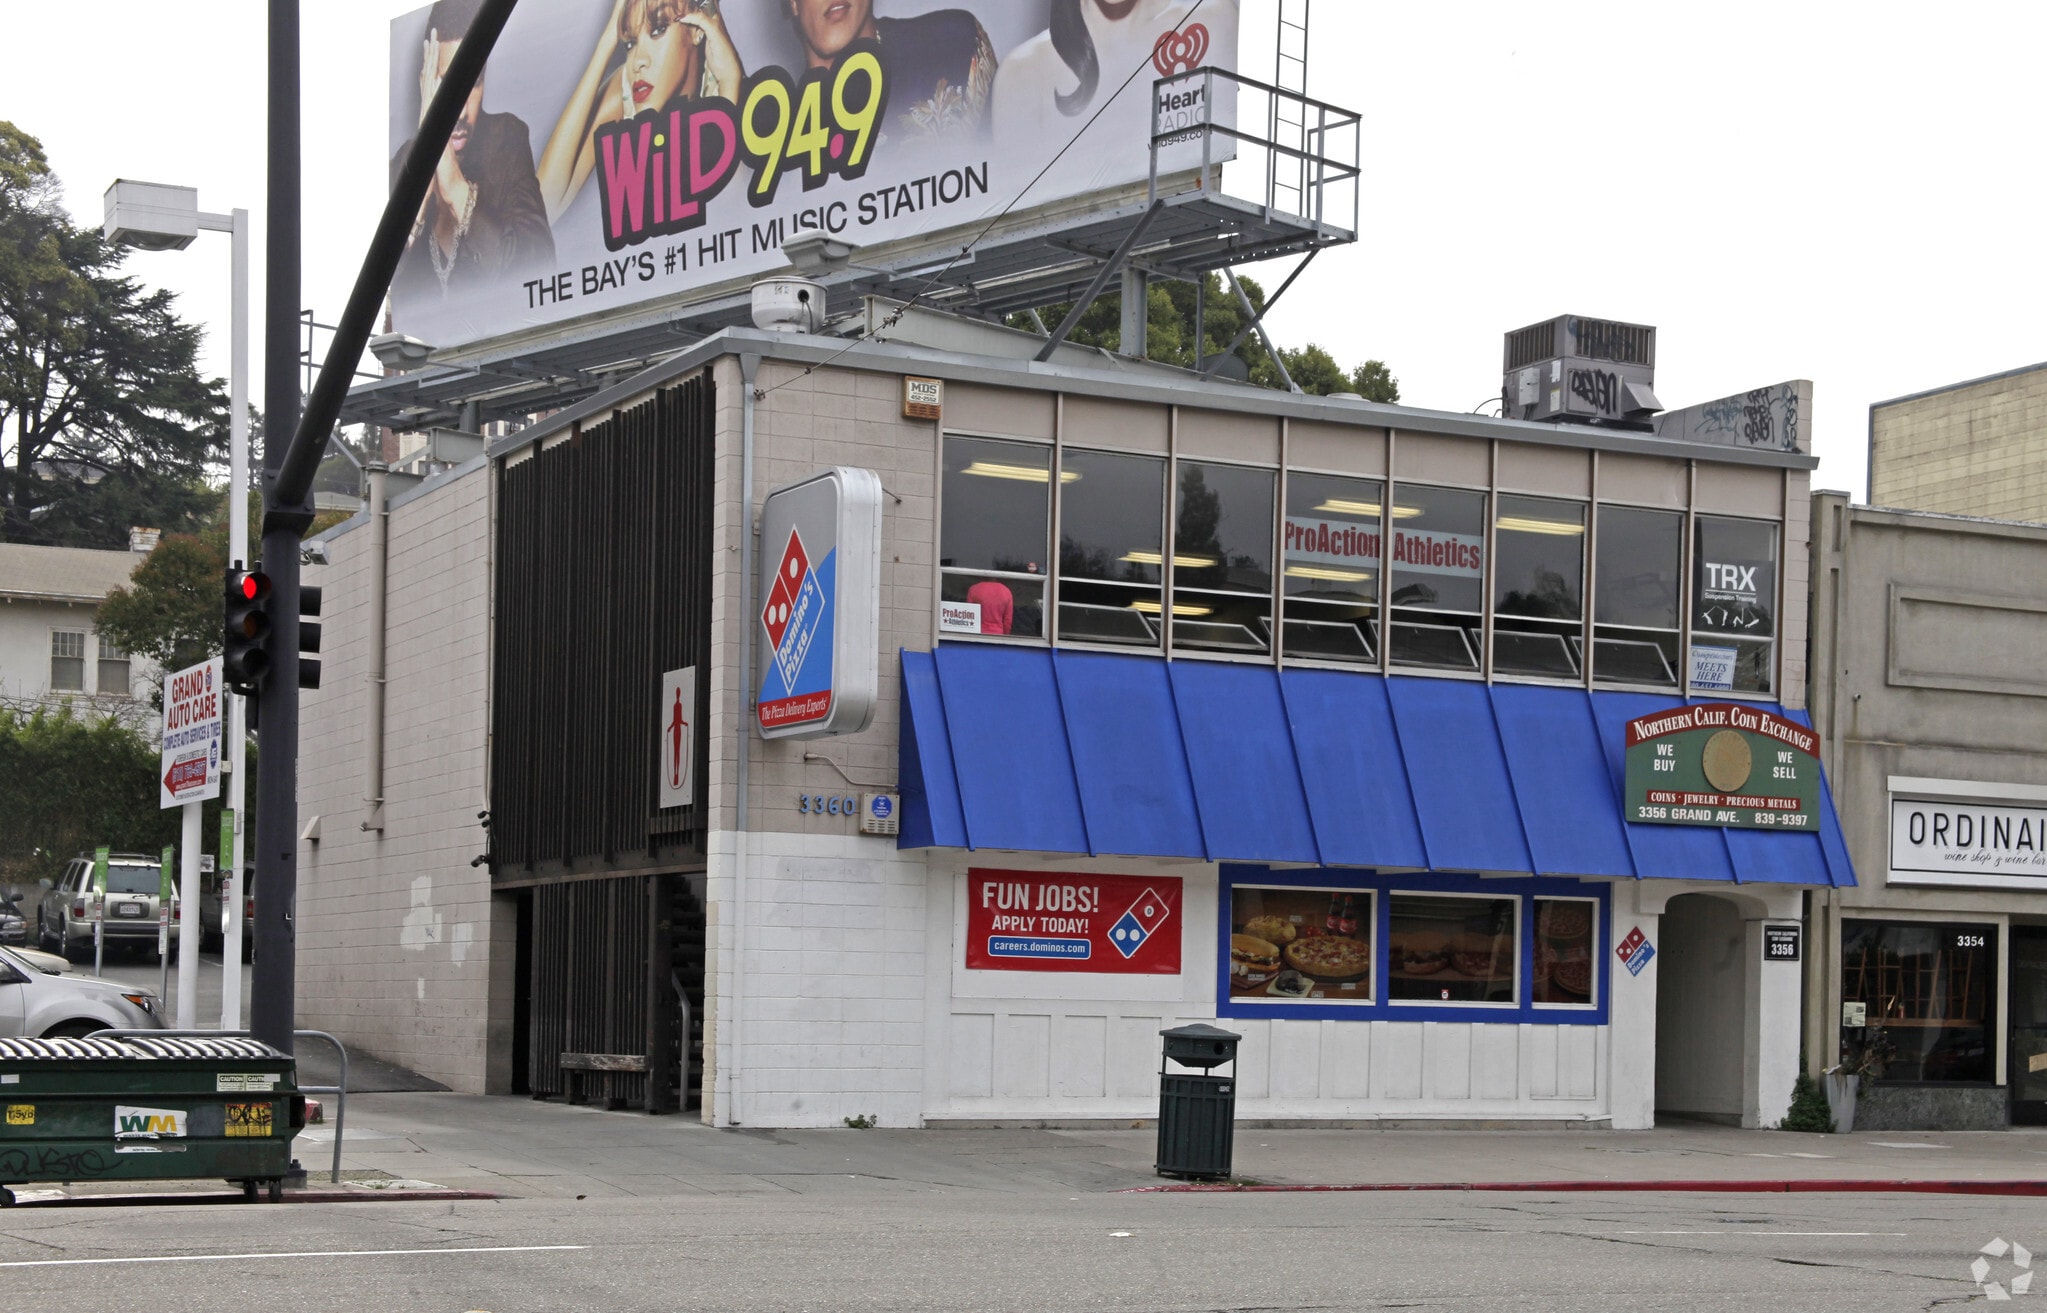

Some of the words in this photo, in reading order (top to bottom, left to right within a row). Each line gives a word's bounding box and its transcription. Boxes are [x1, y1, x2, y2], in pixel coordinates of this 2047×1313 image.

[742, 52, 882, 194] 94.9
[523, 271, 573, 308] THE
[582, 249, 655, 296] BAY'S
[664, 243, 691, 276] #1
[699, 228, 743, 268] HIT
[752, 201, 848, 254] MUSIC
[858, 162, 988, 225] STATION
[911, 382, 937, 394] MDS
[1285, 521, 1379, 558] ProAction
[1394, 532, 1480, 569] Athletics
[1706, 562, 1756, 591] TRX
[942, 608, 975, 620] ProAction
[780, 580, 814, 667] Domino's
[785, 628, 808, 683] Pizza
[1695, 661, 1728, 672] MEETS
[1696, 671, 1724, 681] HERE
[172, 669, 203, 704] GRAND
[167, 702, 190, 731] AUTO
[192, 693, 216, 723] CARE
[761, 705, 771, 721] The
[771, 701, 785, 720] Pizza
[785, 698, 806, 718] Delivery
[806, 696, 827, 714] Experts
[1634, 713, 1692, 741] NORTHERN
[1694, 706, 1728, 726] CALIF.
[1731, 707, 1758, 729] COIN
[1760, 714, 1813, 751] EXCHANGE
[1656, 744, 1674, 756] WE
[1777, 751, 1793, 764] WE
[1653, 759, 1676, 772] BUY
[1772, 766, 1796, 779] SELL
[800, 794, 856, 816] 3360
[1651, 791, 1676, 802] COINS
[1683, 794, 1719, 805] JEWELRY
[1726, 796, 1765, 807] PRECIOUS
[1768, 798, 1797, 809] METALS
[1638, 806, 1666, 819] 3356
[1671, 809, 1711, 821] GRAND
[1716, 810, 1740, 823] AVE.
[1754, 812, 1808, 826] 839-9397
[1944, 852, 1967, 862] wine
[1970, 849, 1992, 865] shop
[2005, 855, 2029, 865] wine
[982, 882, 1030, 910] FUN
[1036, 884, 1100, 913] JOBS!
[992, 915, 1037, 932] APPLY
[1041, 917, 1089, 934] TODAY!
[994, 941, 1086, 954] careers.dominos.com
[1771, 943, 1794, 955] 3356
[1957, 935, 1984, 947] 3354
[1627, 943, 1650, 969] Domino's
[1631, 959, 1645, 974] Pizza
[119, 1115, 178, 1132] WM
